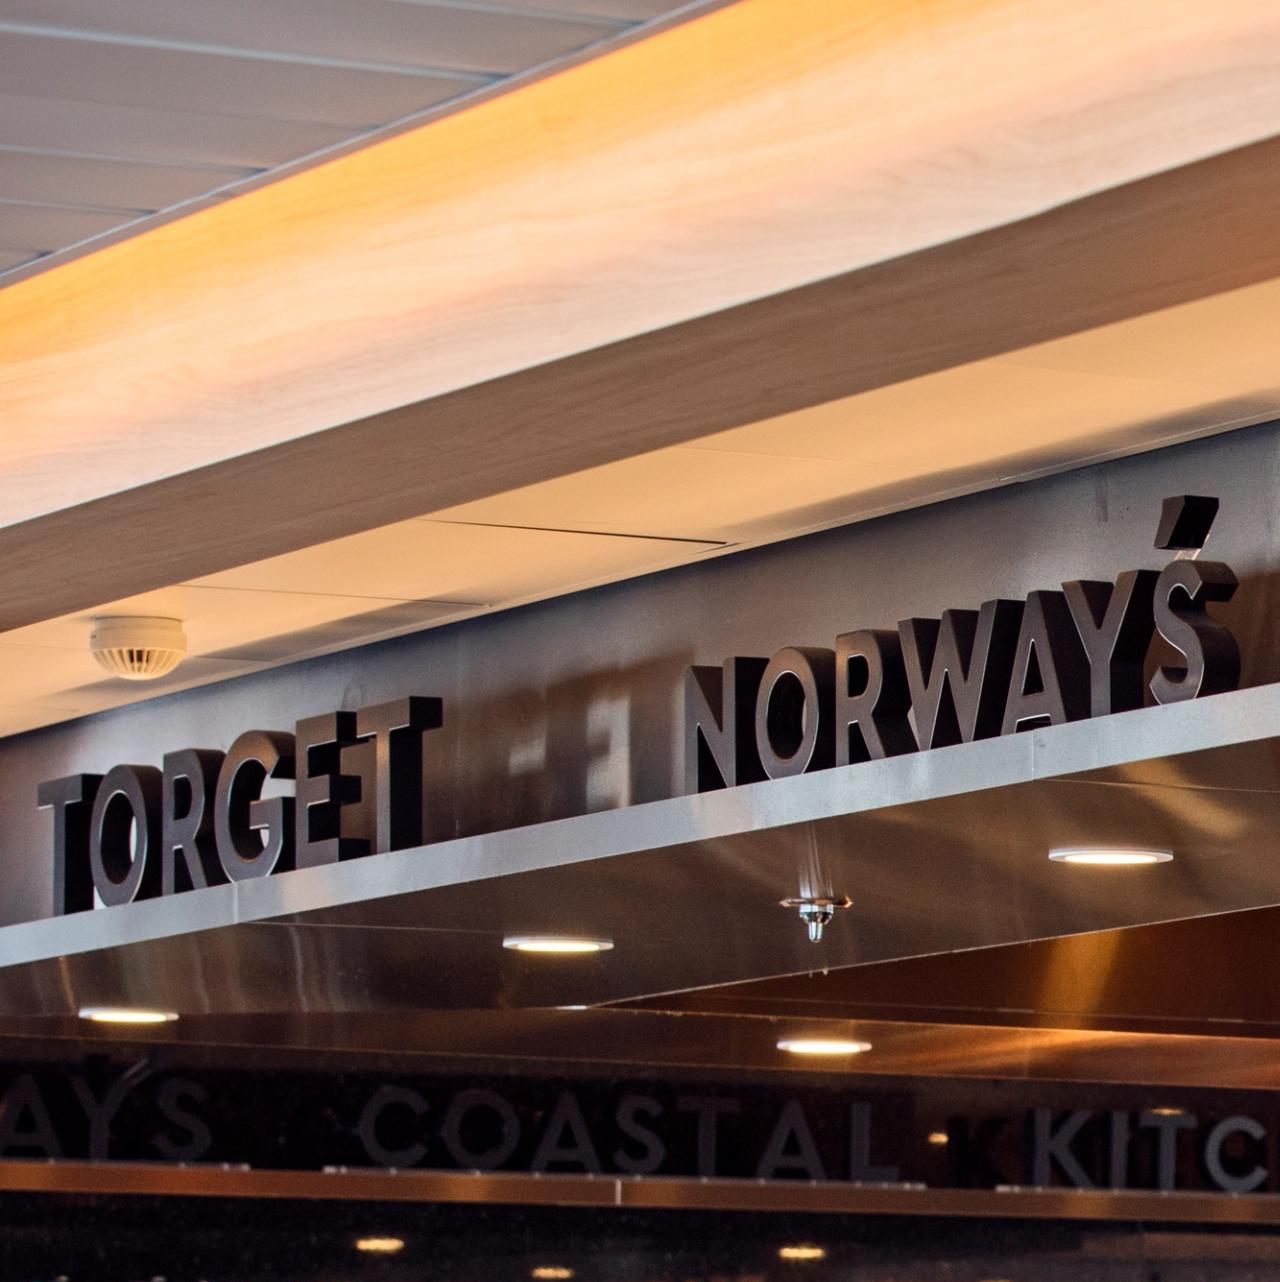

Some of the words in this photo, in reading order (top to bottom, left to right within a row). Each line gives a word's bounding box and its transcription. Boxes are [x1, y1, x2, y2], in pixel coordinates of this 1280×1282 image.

[37, 696, 443, 916] TORGET
[683, 495, 1241, 795] NORWAY'S
[358, 1084, 898, 1182] COASTAL
